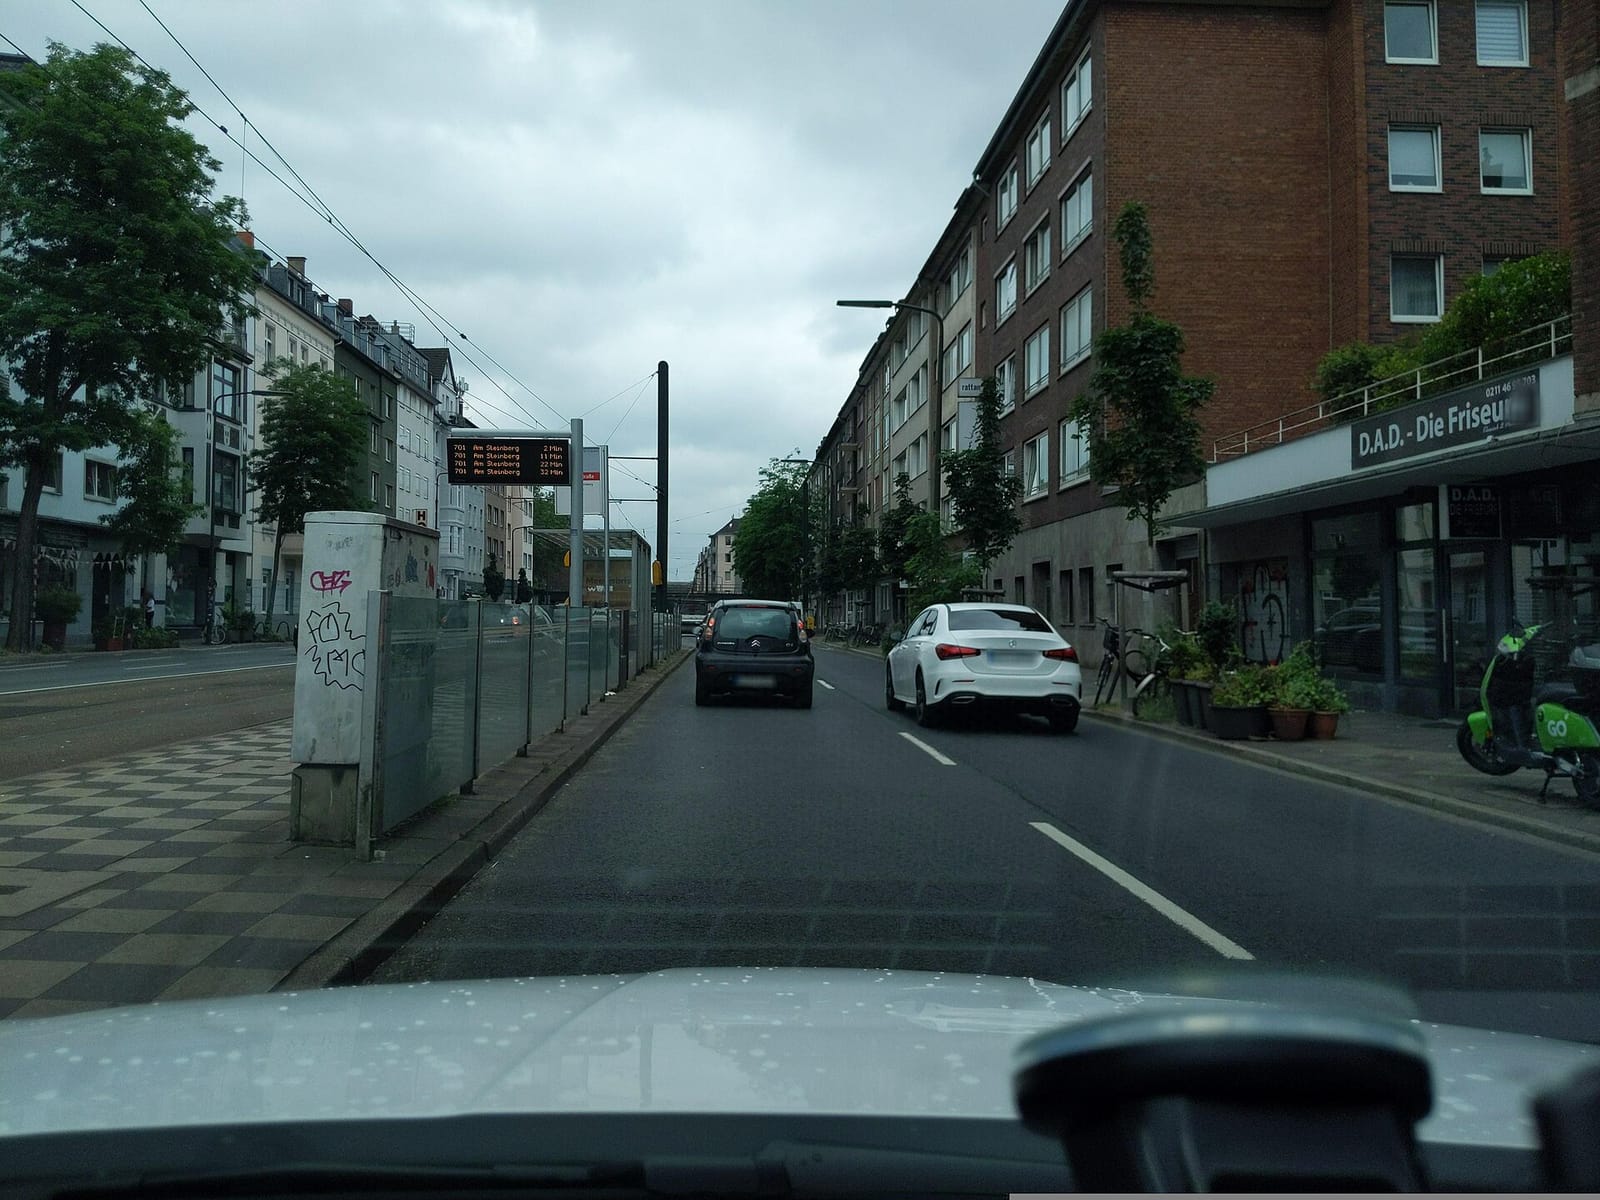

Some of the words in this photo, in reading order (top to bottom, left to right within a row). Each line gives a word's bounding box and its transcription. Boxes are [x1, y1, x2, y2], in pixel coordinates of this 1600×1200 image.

[1358, 423, 1404, 456] D.A.D.
[1416, 412, 1445, 442] Die
[1547, 719, 1568, 737] GO
